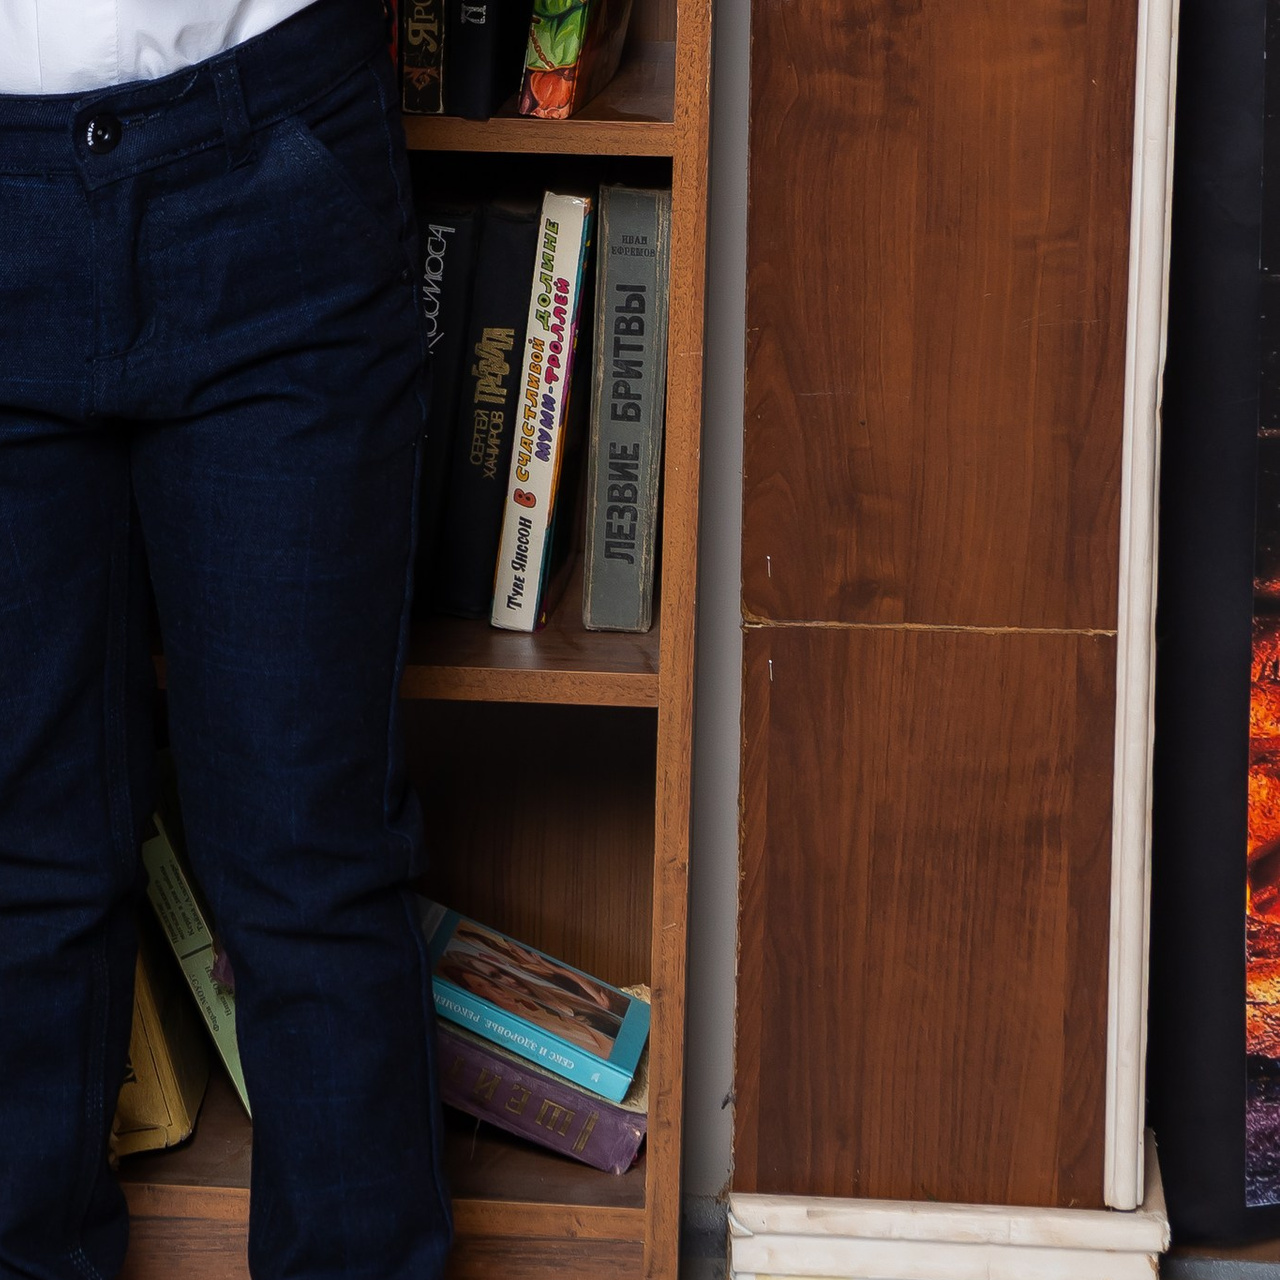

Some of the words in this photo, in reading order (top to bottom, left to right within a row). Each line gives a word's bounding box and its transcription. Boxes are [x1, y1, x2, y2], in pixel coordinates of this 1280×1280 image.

[516, 336, 545, 482] СЧАСТЛИВОЙ
[532, 218, 560, 331] ДОЛИНЕ
[535, 277, 570, 462] МУМИ-ТРОЛЛЕЙ
[611, 284, 647, 423] БРИТВЫ
[469, 410, 489, 466] СЕРГЕЙ
[604, 442, 641, 565] ЛЕЗВИЕ
[547, 1050, 575, 1070] СЕКС
